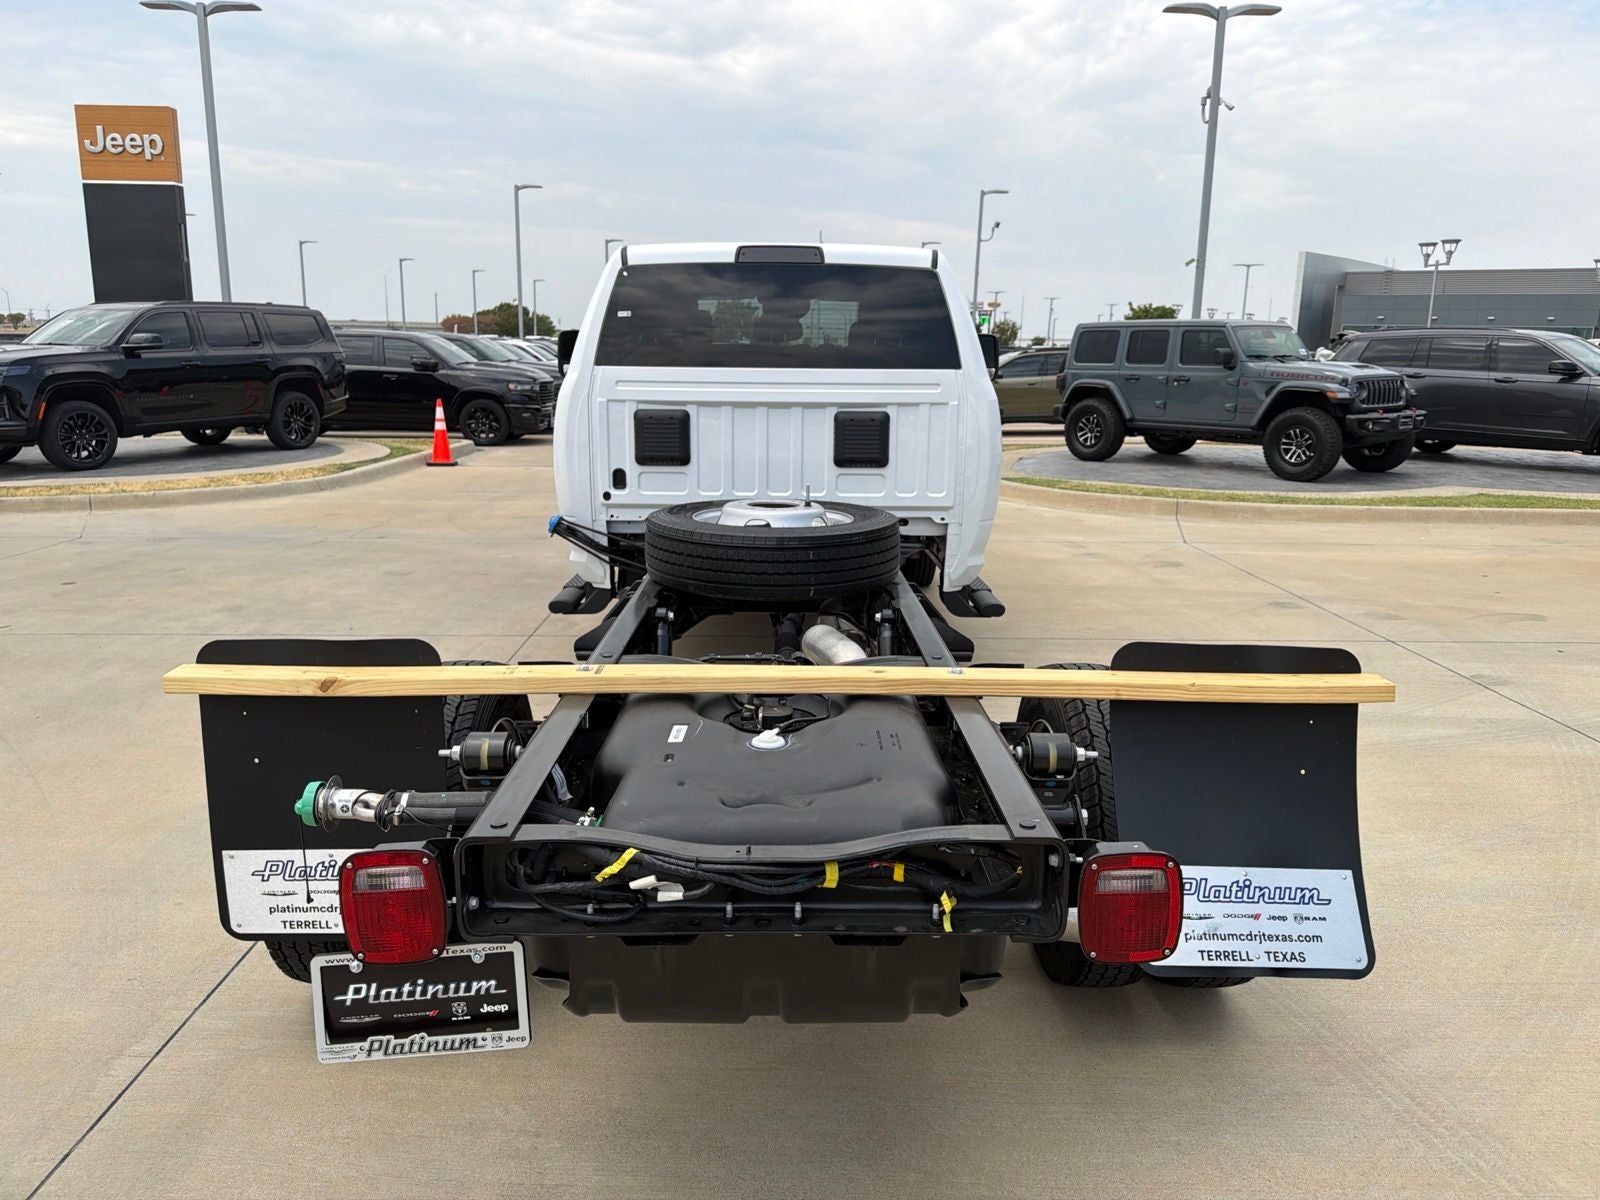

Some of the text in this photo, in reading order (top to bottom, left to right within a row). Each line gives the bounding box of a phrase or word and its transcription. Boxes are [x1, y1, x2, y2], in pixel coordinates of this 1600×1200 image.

[84, 125, 163, 160] Jeep
[251, 859, 340, 882] Plati
[281, 920, 332, 929] TERRELL
[1266, 914, 1288, 922] Jeep
[1184, 929, 1323, 945] platinumcdrjtexas.com
[1198, 950, 1306, 963] TERRELL TEXAS
[333, 978, 507, 1006] Platinum
[480, 1003, 509, 1014] Jeep
[365, 1034, 486, 1058] Platinum
[505, 1035, 527, 1043] Jeep
